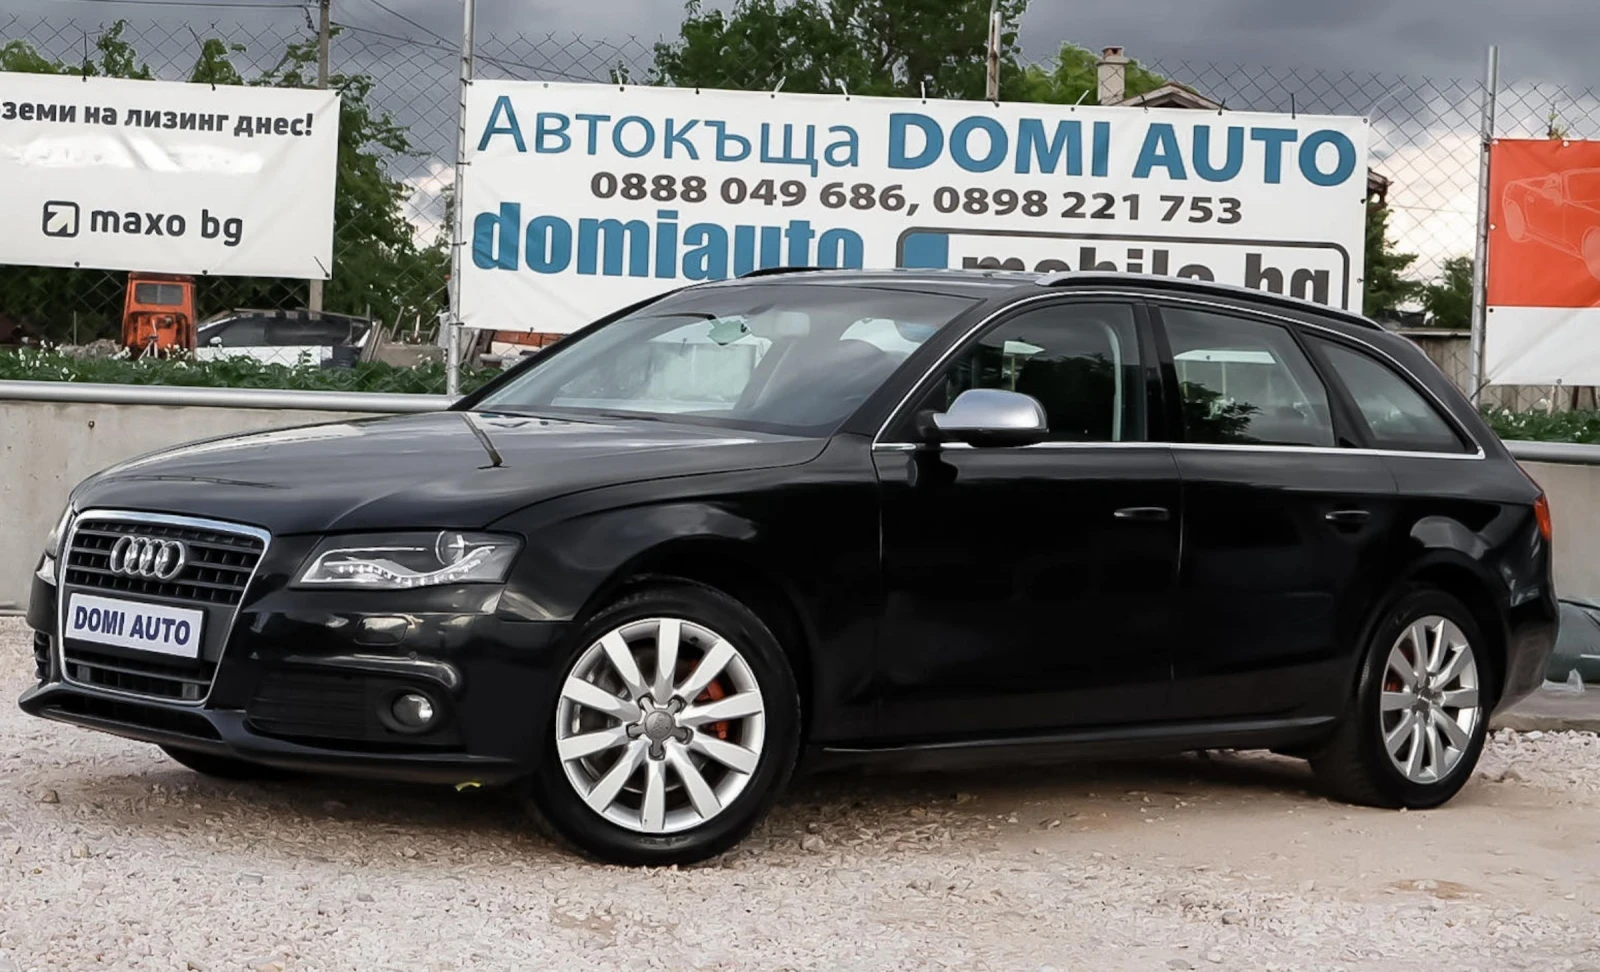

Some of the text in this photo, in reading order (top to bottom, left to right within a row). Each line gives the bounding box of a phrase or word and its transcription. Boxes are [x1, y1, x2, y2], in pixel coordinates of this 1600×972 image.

[0, 102, 314, 137] земи на лизинг днес!
[477, 96, 1357, 187] Автокъща DOMI AUTO
[590, 172, 1243, 224] 0888 049 686, 0898 221 753
[90, 208, 244, 247] maxo bg
[471, 201, 865, 282] domiauto
[73, 605, 191, 646] DOMI AUTO
